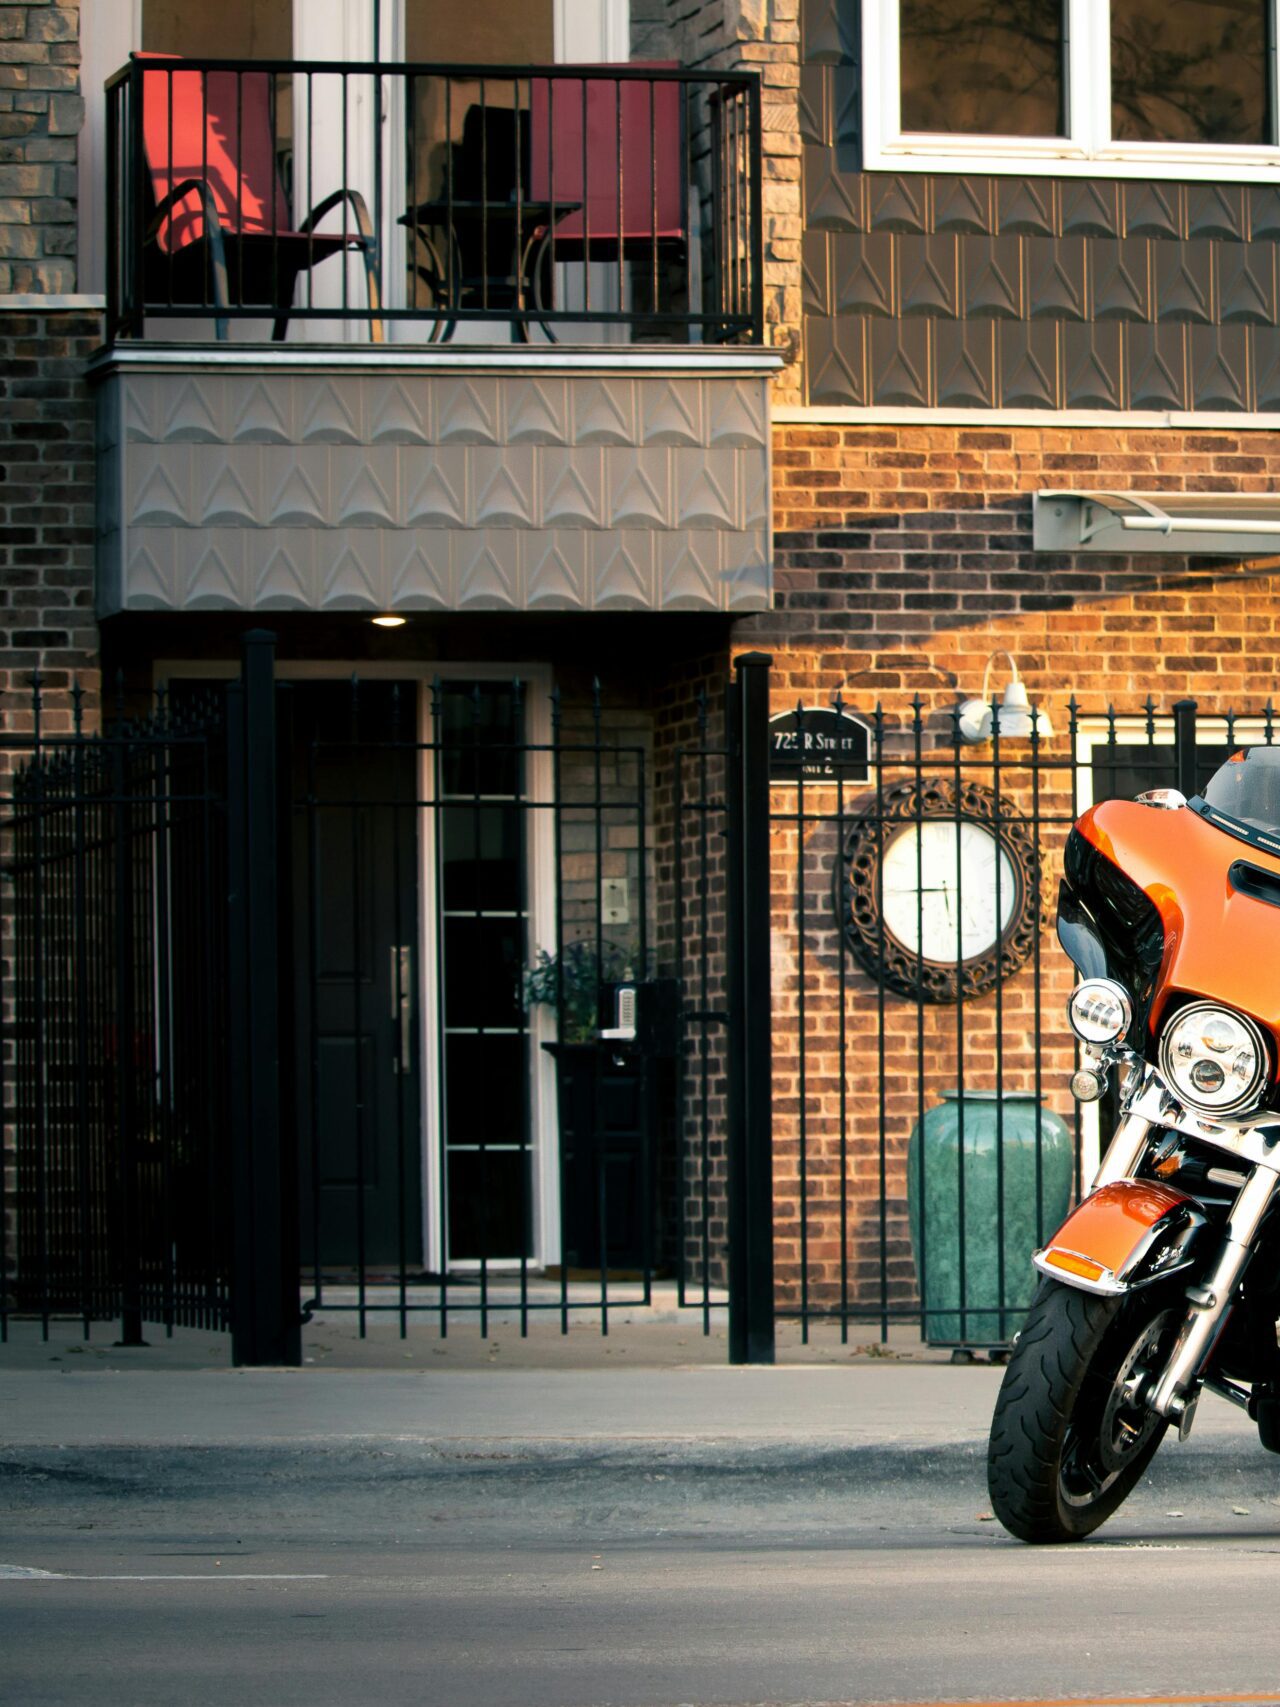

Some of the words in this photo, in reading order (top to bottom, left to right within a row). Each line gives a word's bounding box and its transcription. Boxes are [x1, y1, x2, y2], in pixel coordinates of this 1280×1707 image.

[804, 732, 813, 749] R
[816, 732, 854, 749] STRET
[824, 756, 834, 774] 2
